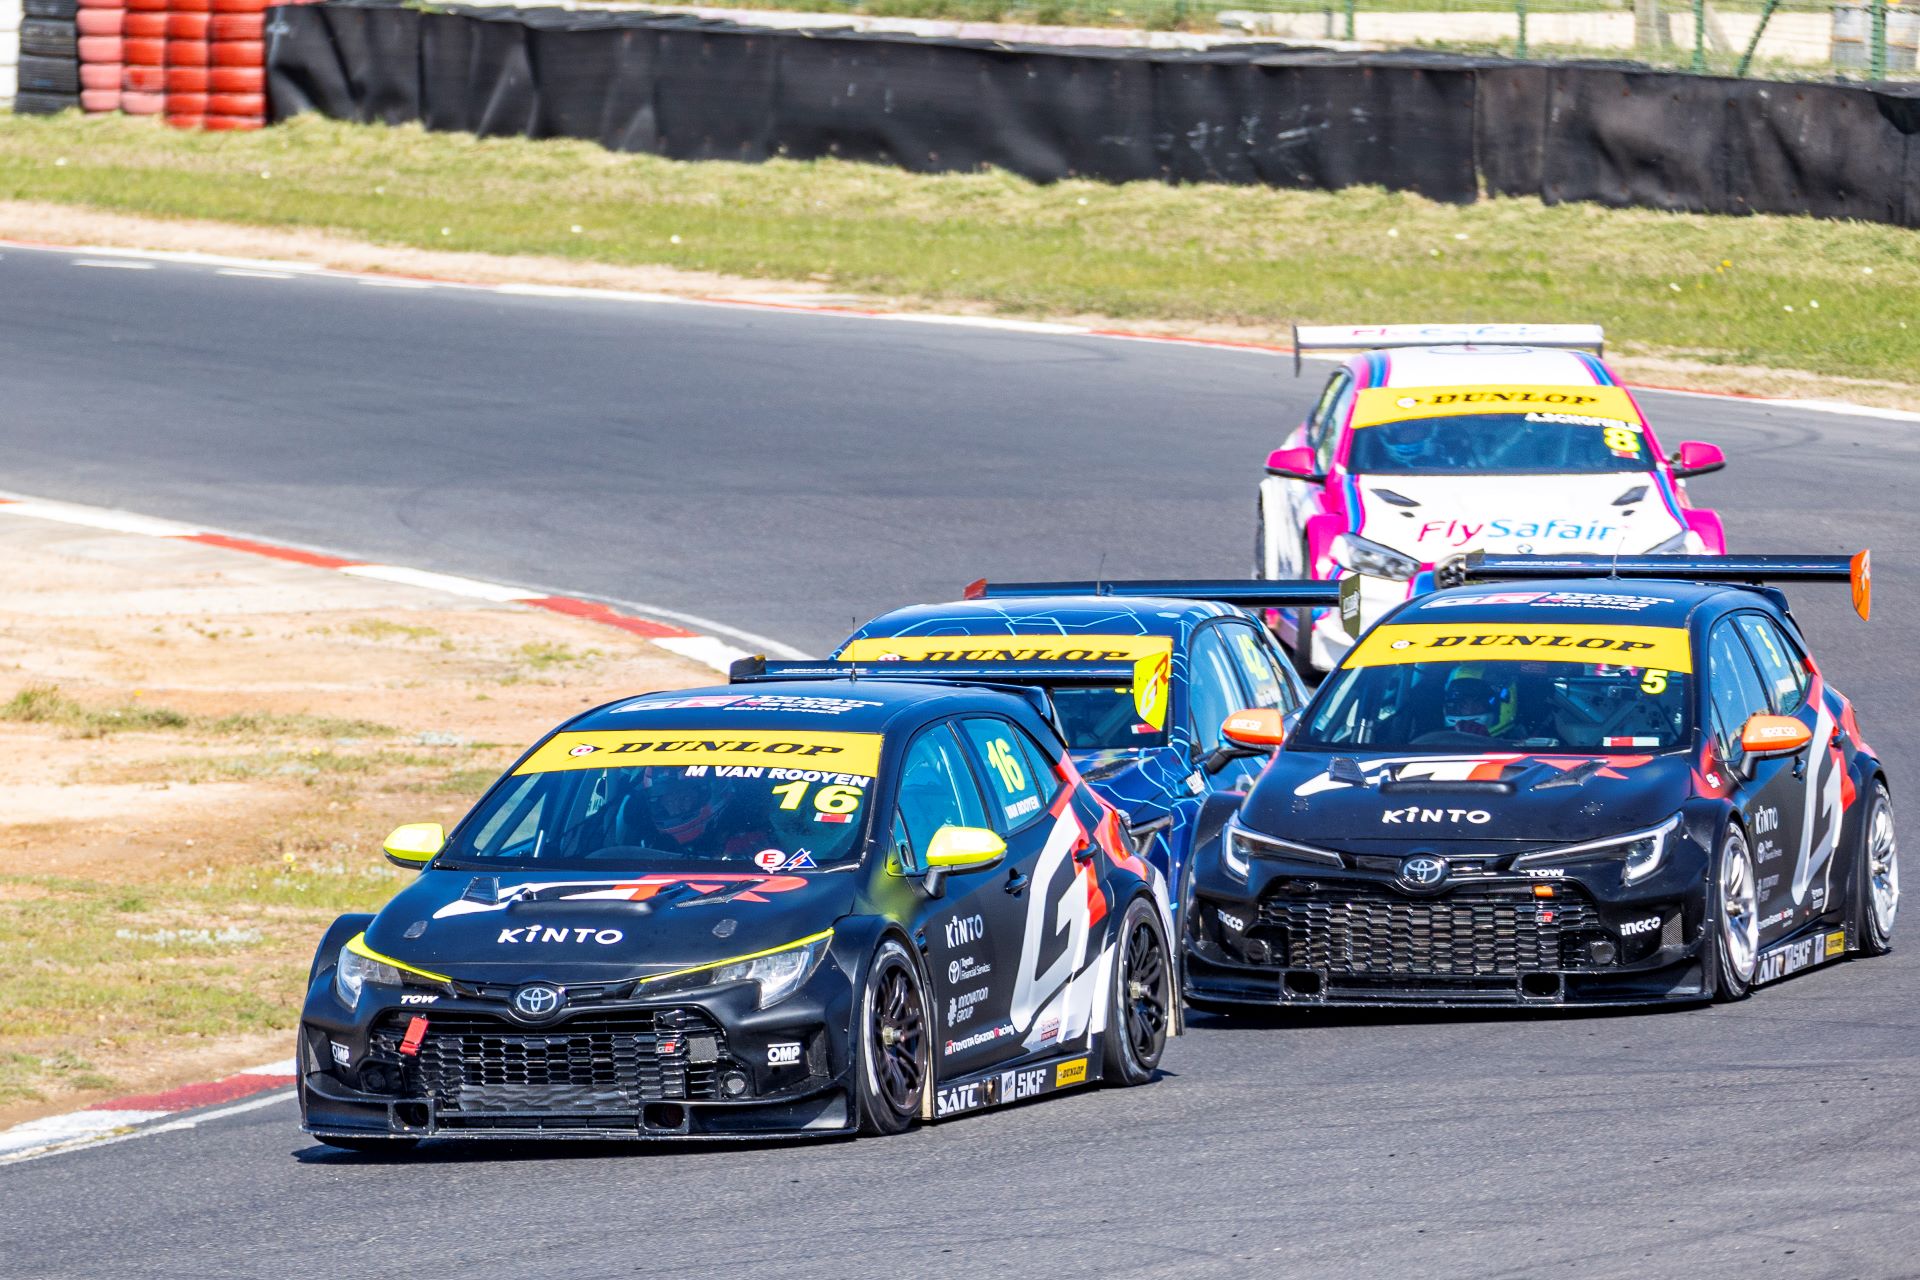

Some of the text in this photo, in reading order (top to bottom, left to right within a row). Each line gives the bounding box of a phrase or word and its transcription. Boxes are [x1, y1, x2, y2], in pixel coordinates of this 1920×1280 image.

[1430, 393, 1599, 406] DUNLOP
[1603, 427, 1641, 453] 8
[1417, 518, 1616, 547] FlySafair
[1424, 635, 1656, 652] DUNLOP
[1641, 668, 1668, 694] 5
[608, 740, 845, 756] DUNLOP
[985, 738, 1025, 793] 16
[685, 765, 870, 787] M VAN ROOYEN
[771, 781, 864, 814] 16
[1527, 869, 1564, 877] TOW
[400, 995, 439, 1005] TOW
[332, 1044, 350, 1063] OMP
[656, 1042, 676, 1053] GR
[767, 1046, 800, 1062] OMP
[1017, 1069, 1046, 1098] SKF
